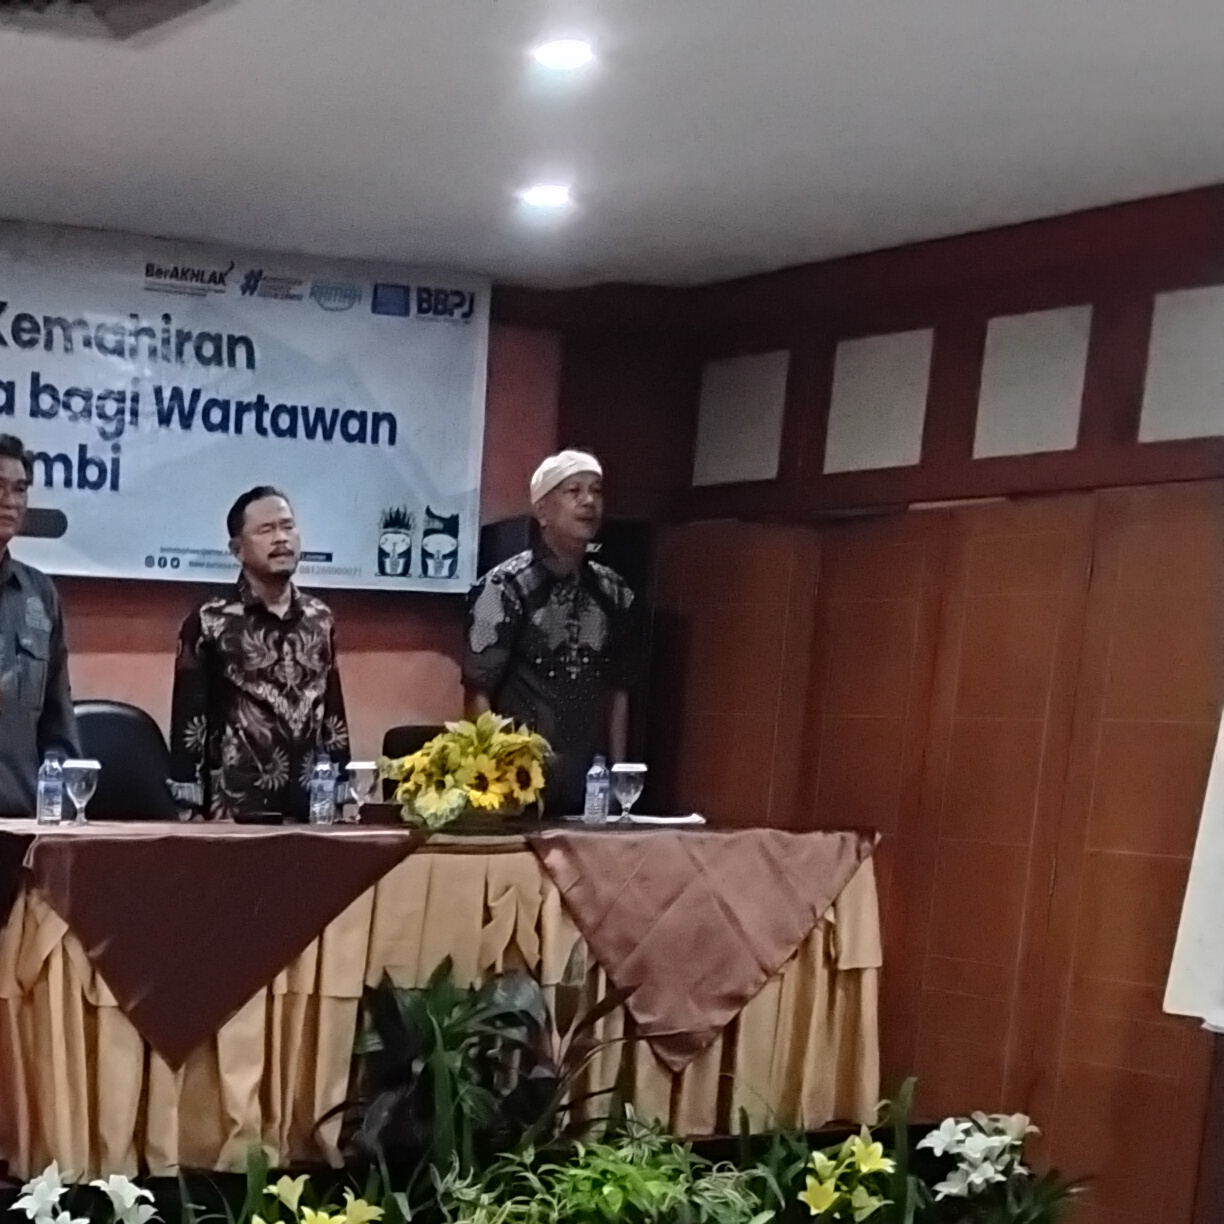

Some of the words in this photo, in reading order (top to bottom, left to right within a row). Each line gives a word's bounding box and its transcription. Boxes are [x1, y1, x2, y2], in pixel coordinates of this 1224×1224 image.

[29, 371, 140, 441] bagi
[154, 384, 398, 447] Wartawan
[27, 442, 122, 492] mbi
